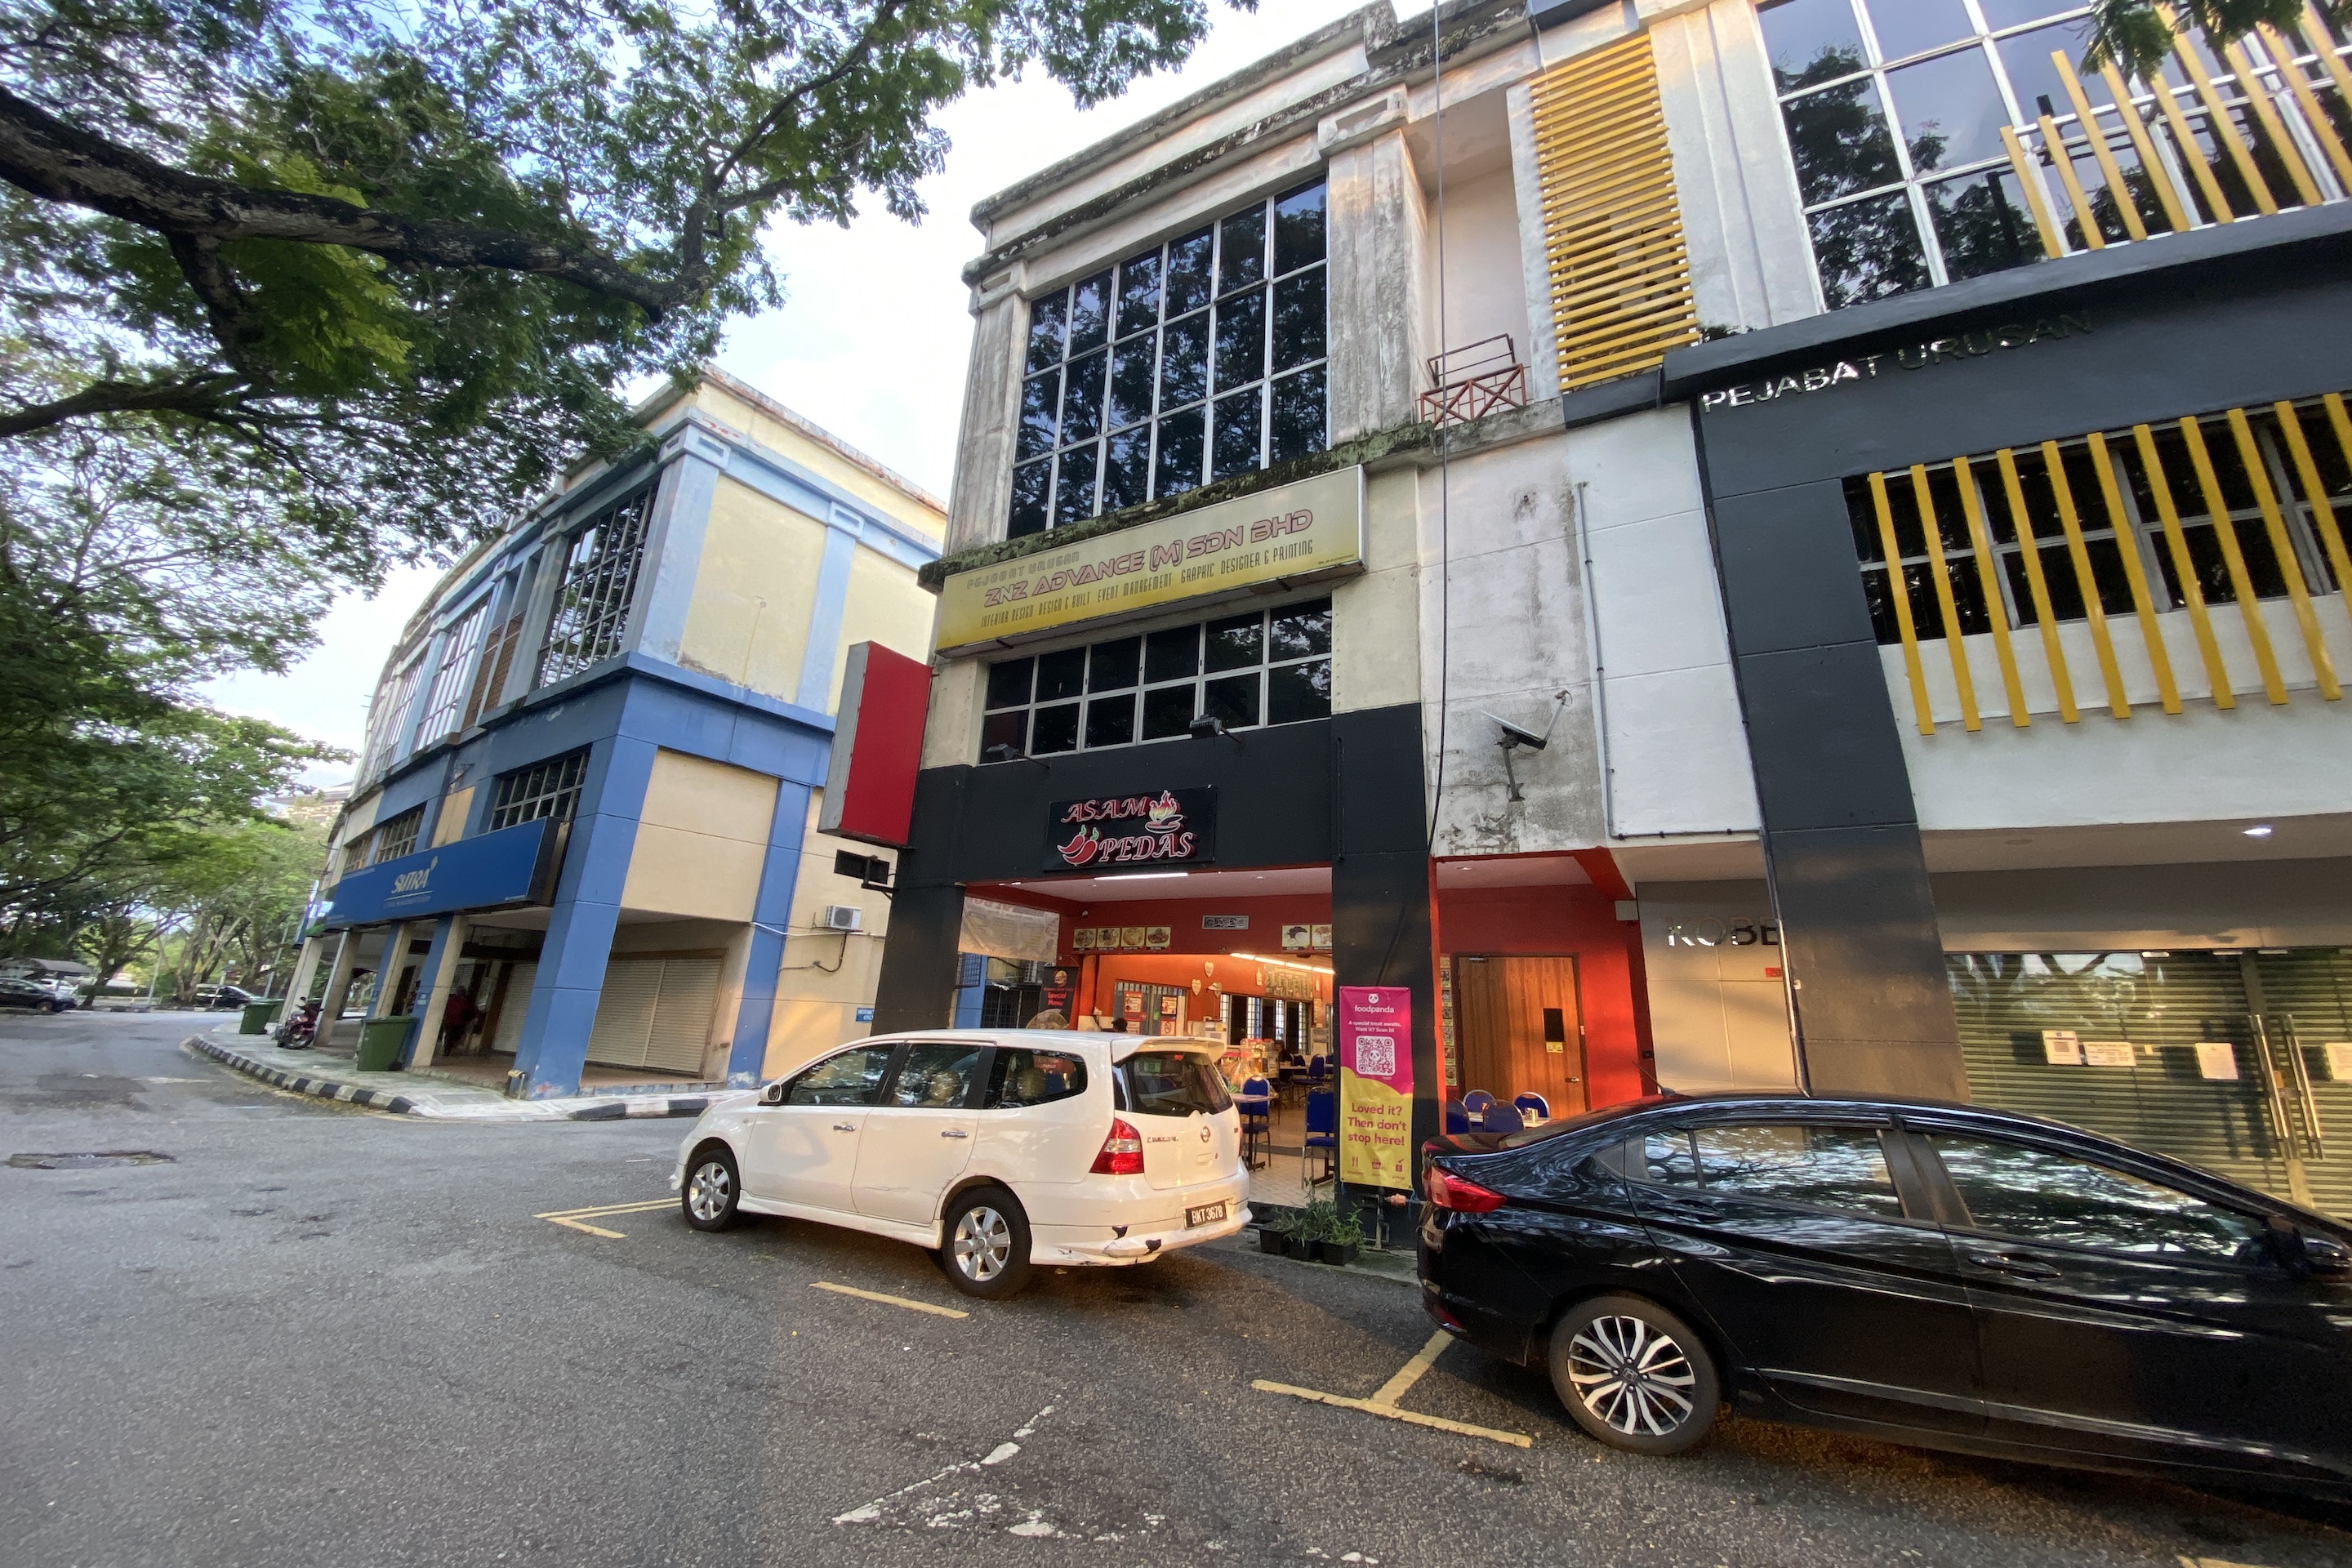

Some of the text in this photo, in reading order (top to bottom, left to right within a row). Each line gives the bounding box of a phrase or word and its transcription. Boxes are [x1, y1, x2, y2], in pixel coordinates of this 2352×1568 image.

[1700, 310, 2093, 414] PEJABAT URUSAN
[967, 551, 1080, 590] PEJABAT URUSAN
[983, 581, 1028, 608] ZNZ
[1031, 550, 1146, 596] ADVANCE
[1186, 525, 1243, 559] SDN
[1250, 509, 1313, 543] BHD
[981, 610, 1009, 628] INTERIOR
[1011, 604, 1034, 621] DESIGN
[1038, 598, 1062, 616] DESIGN
[1071, 591, 1091, 608] BUILT
[1098, 585, 1120, 603] EVENT
[1123, 572, 1172, 597] MANAGEMENT
[1181, 563, 1215, 583] GRAPHIC
[1220, 552, 1261, 575] DESIGNER
[1060, 796, 1147, 824] ASAM
[1098, 831, 1195, 862] PEDAS
[1354, 1004, 1395, 1014] foodpanda
[1352, 1102, 1402, 1116] Loved it?
[1348, 1116, 1406, 1131] Then don't
[1348, 1133, 1405, 1146] stop here!
[1192, 1205, 1223, 1224] BKT 3678
